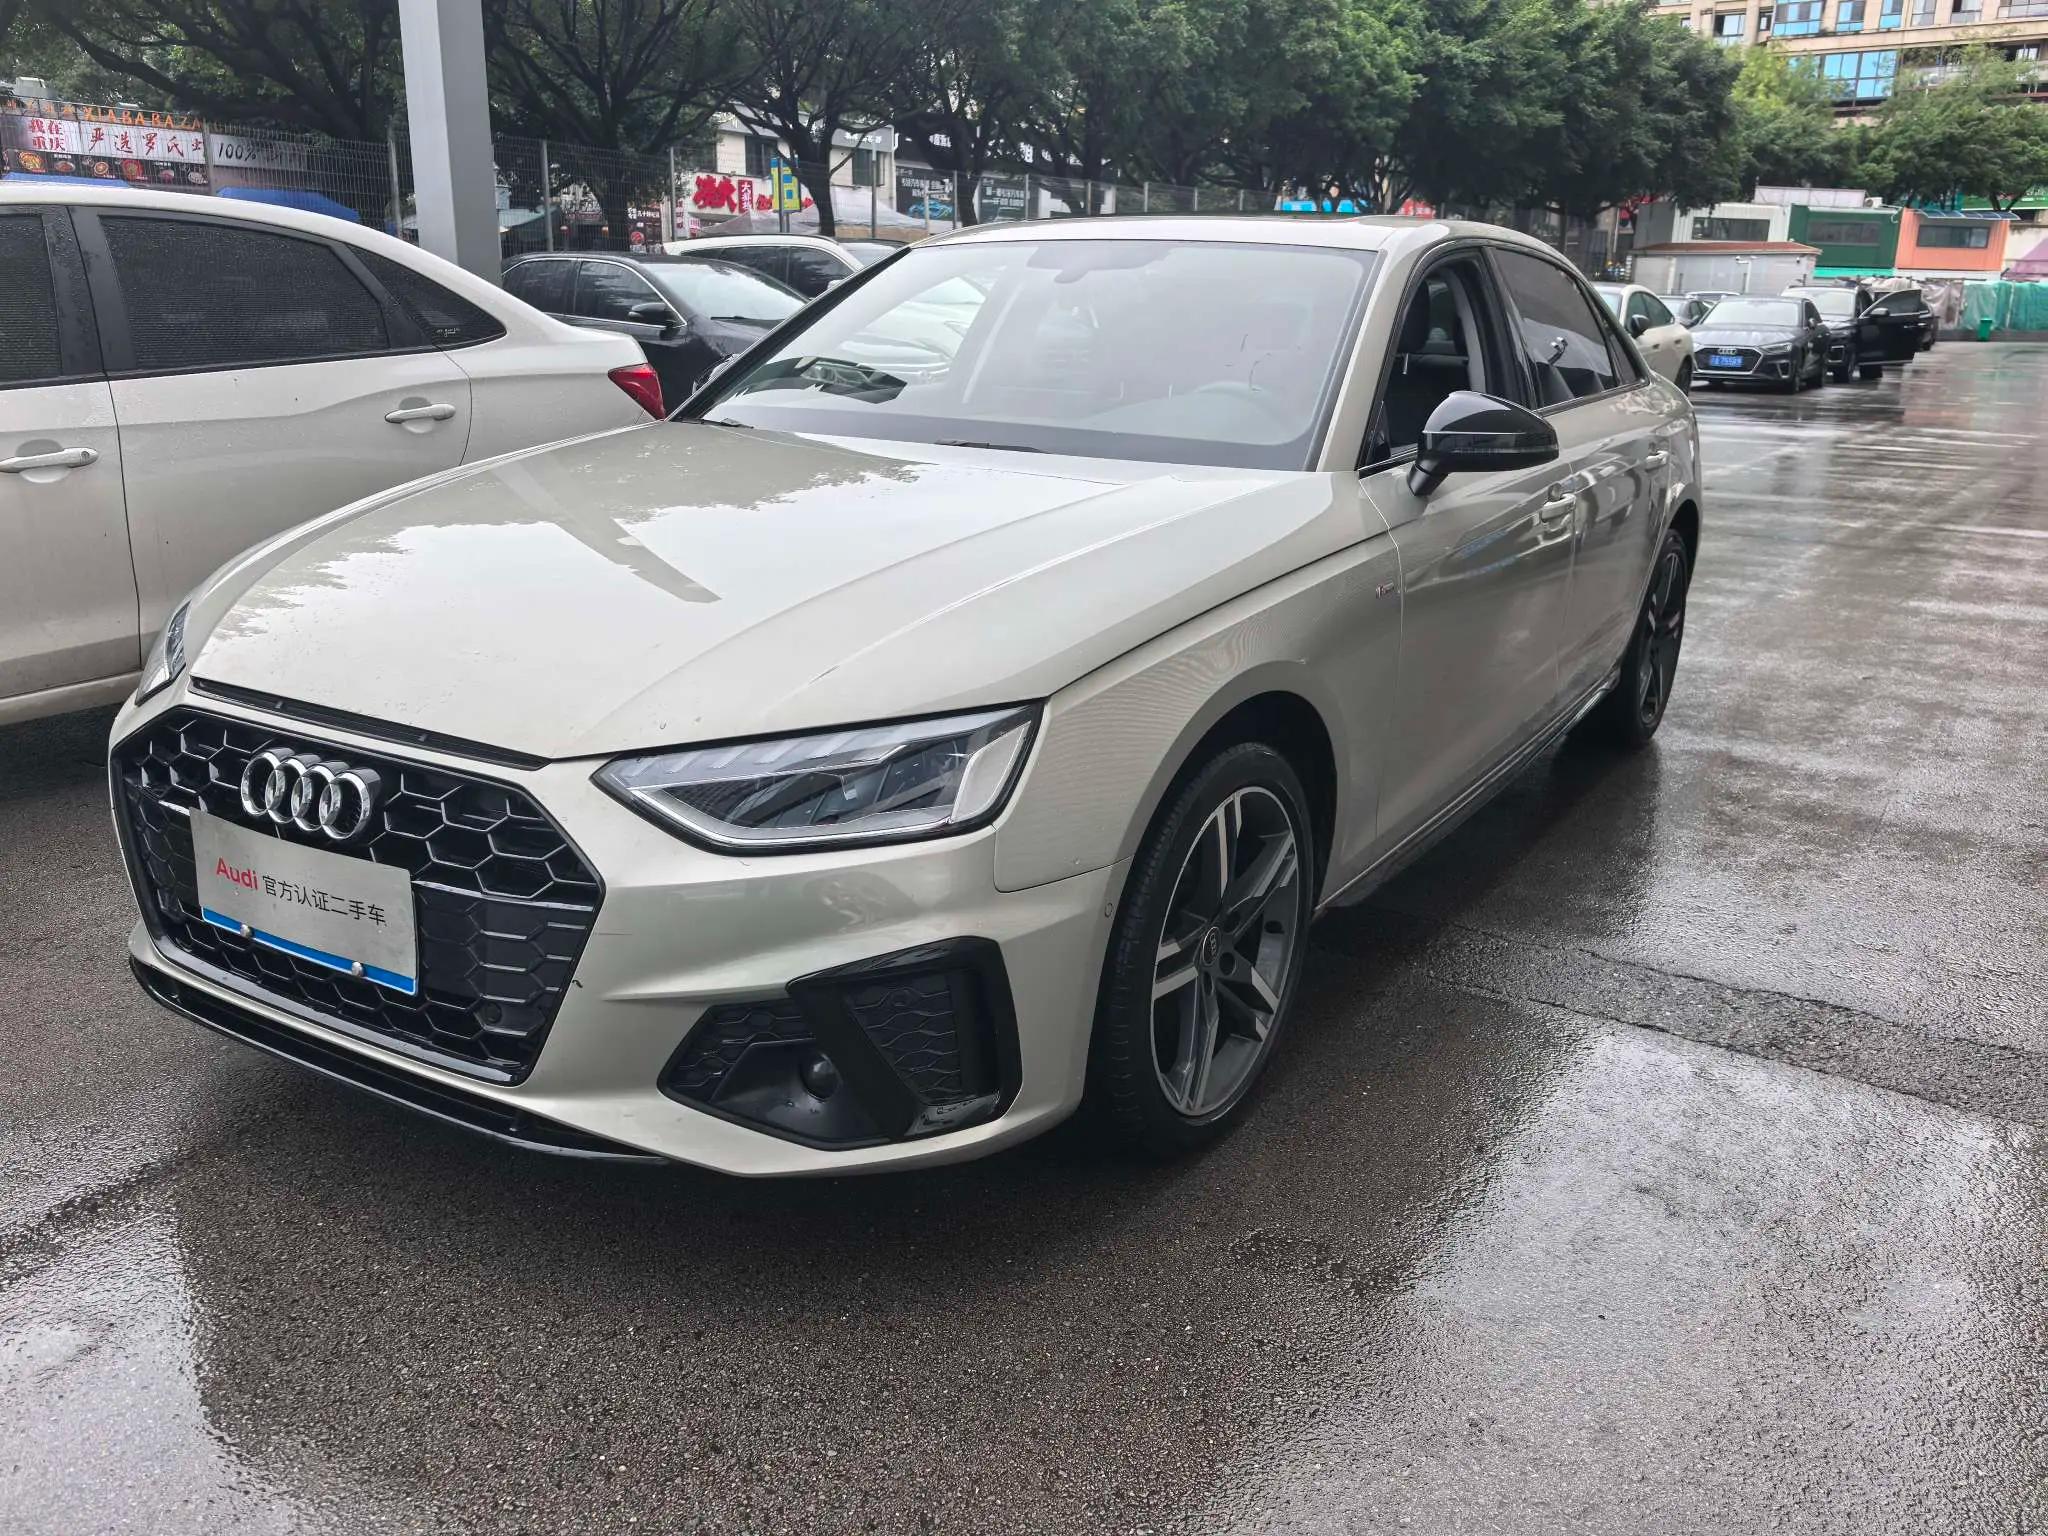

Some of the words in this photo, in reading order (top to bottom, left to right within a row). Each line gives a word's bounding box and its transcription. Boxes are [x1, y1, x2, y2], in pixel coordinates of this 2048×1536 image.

[216, 857, 259, 891] Audi
[262, 874, 387, 926] 官方认证二手车
